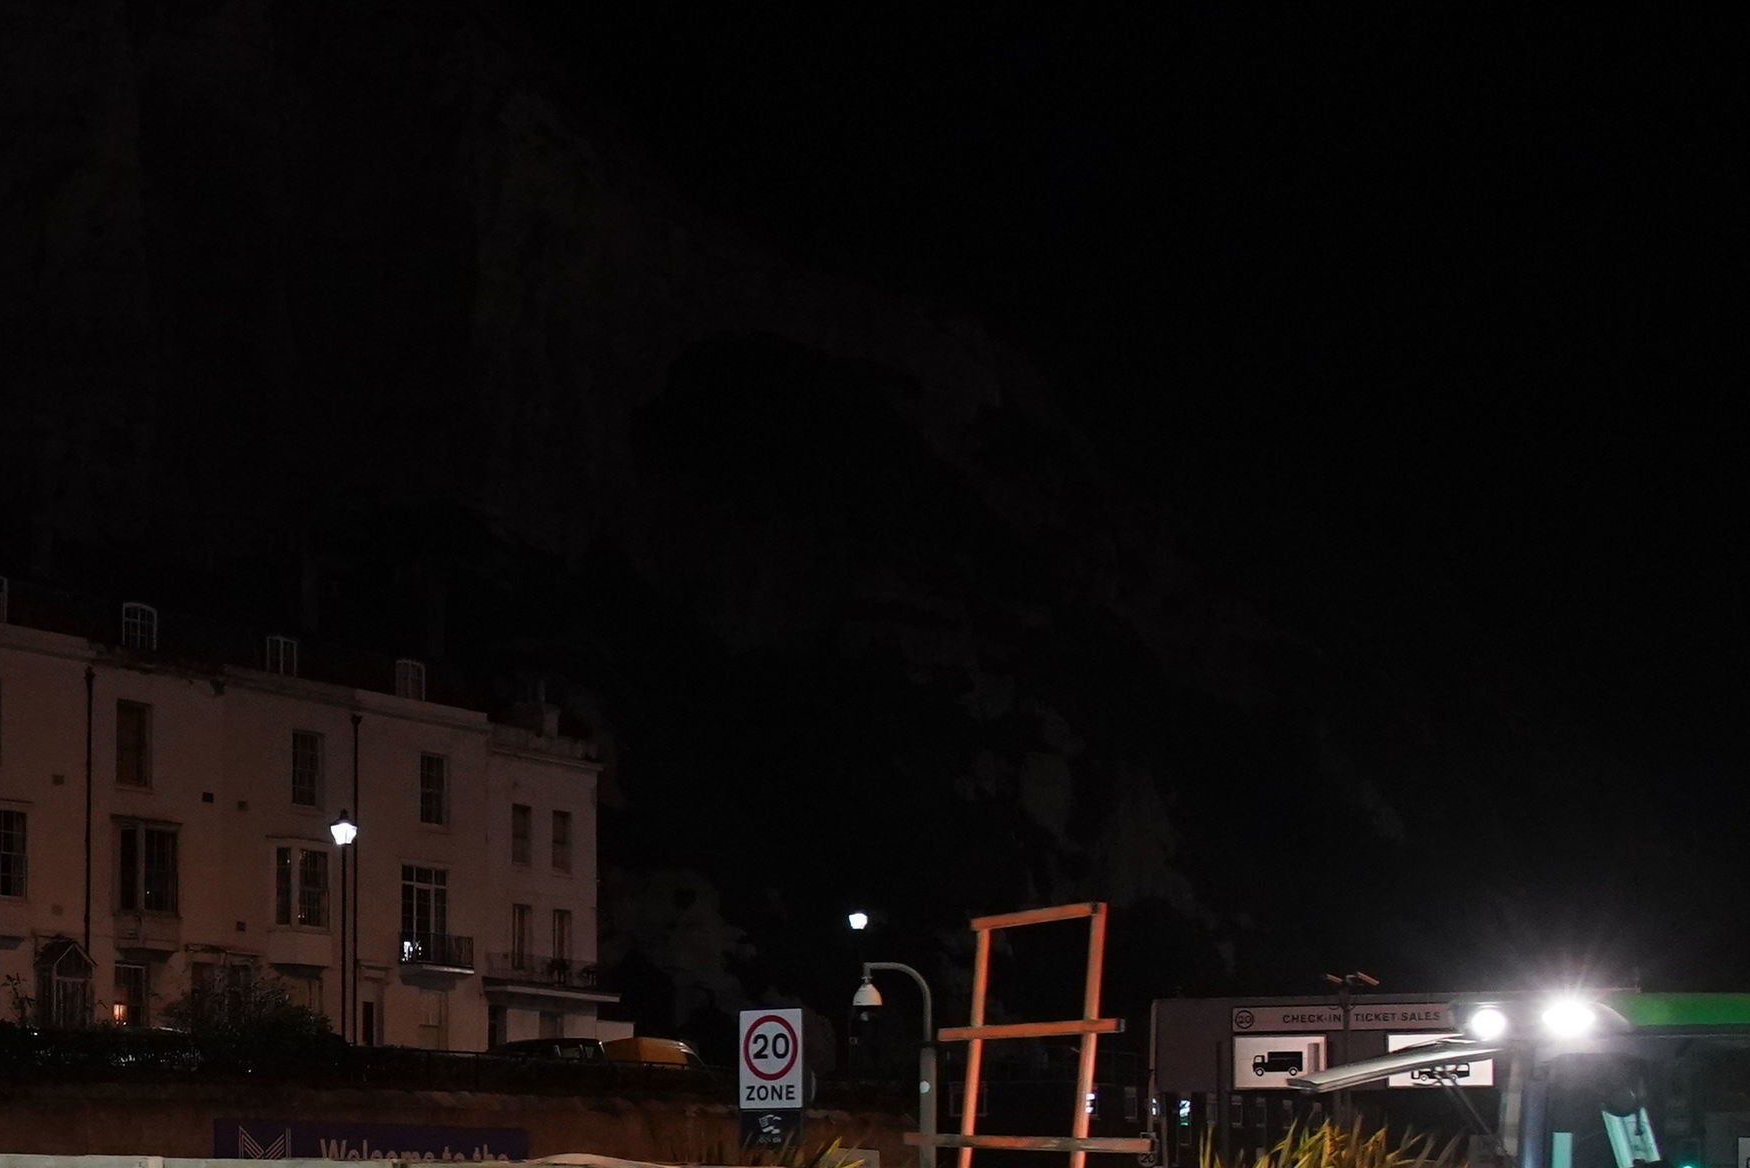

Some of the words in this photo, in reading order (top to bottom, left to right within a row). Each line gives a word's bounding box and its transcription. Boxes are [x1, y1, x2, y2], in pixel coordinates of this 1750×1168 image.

[1282, 1013, 1342, 1024] CHECK-IN
[1353, 1012, 1397, 1022] TICKET
[1400, 1011, 1441, 1022] SALES
[753, 1032, 790, 1059] 20
[746, 1085, 795, 1101] ZONE
